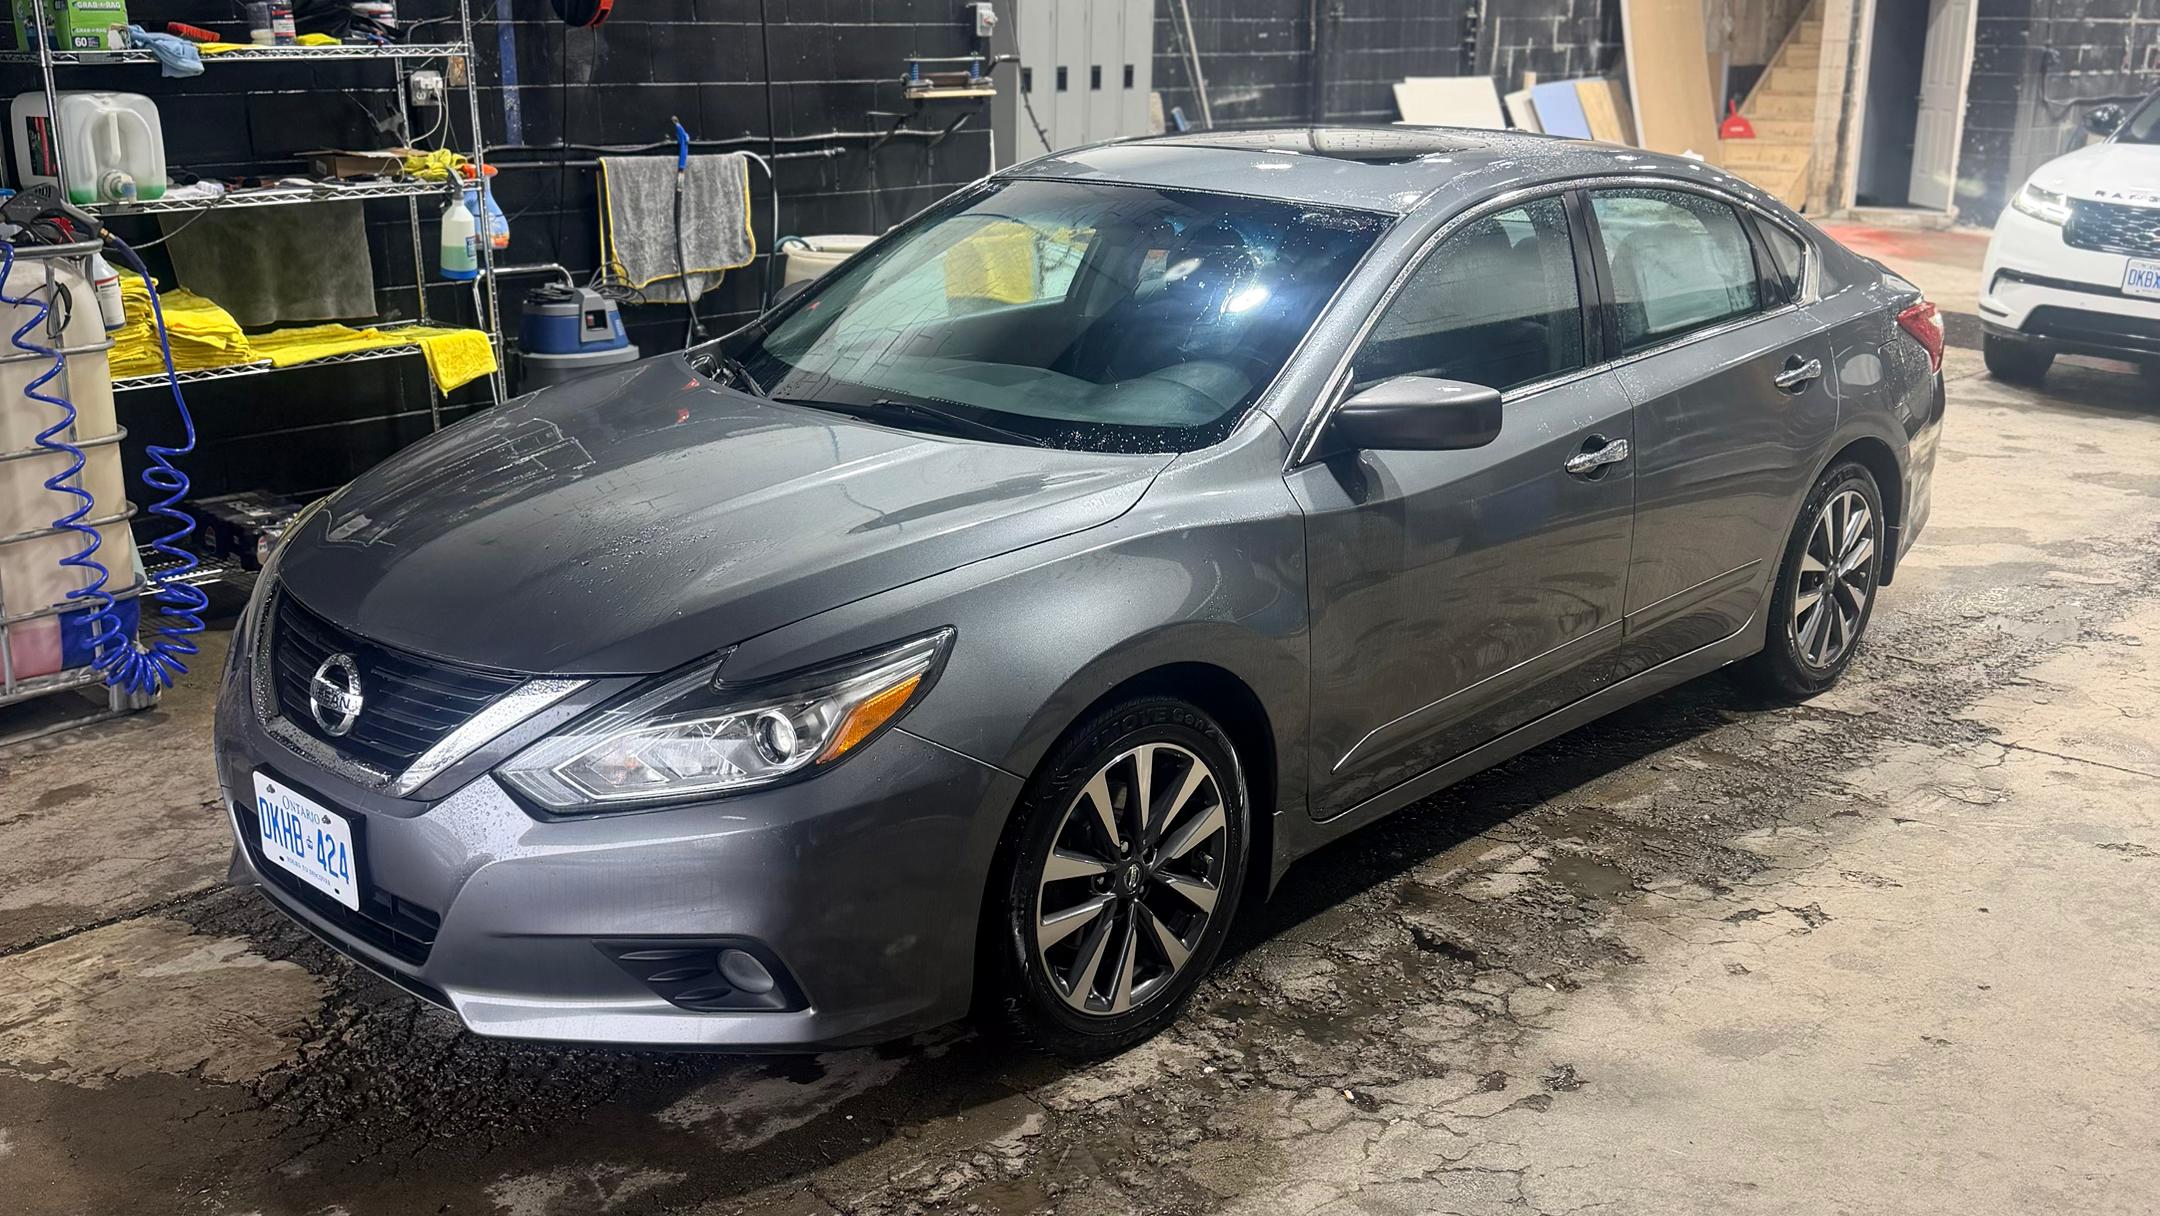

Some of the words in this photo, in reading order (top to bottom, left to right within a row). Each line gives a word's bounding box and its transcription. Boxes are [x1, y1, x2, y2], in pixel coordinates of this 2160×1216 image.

[74, 37, 88, 47] 60
[282, 795, 320, 825] ONTARIO
[259, 797, 305, 859] DKHB
[317, 828, 350, 885] 424
